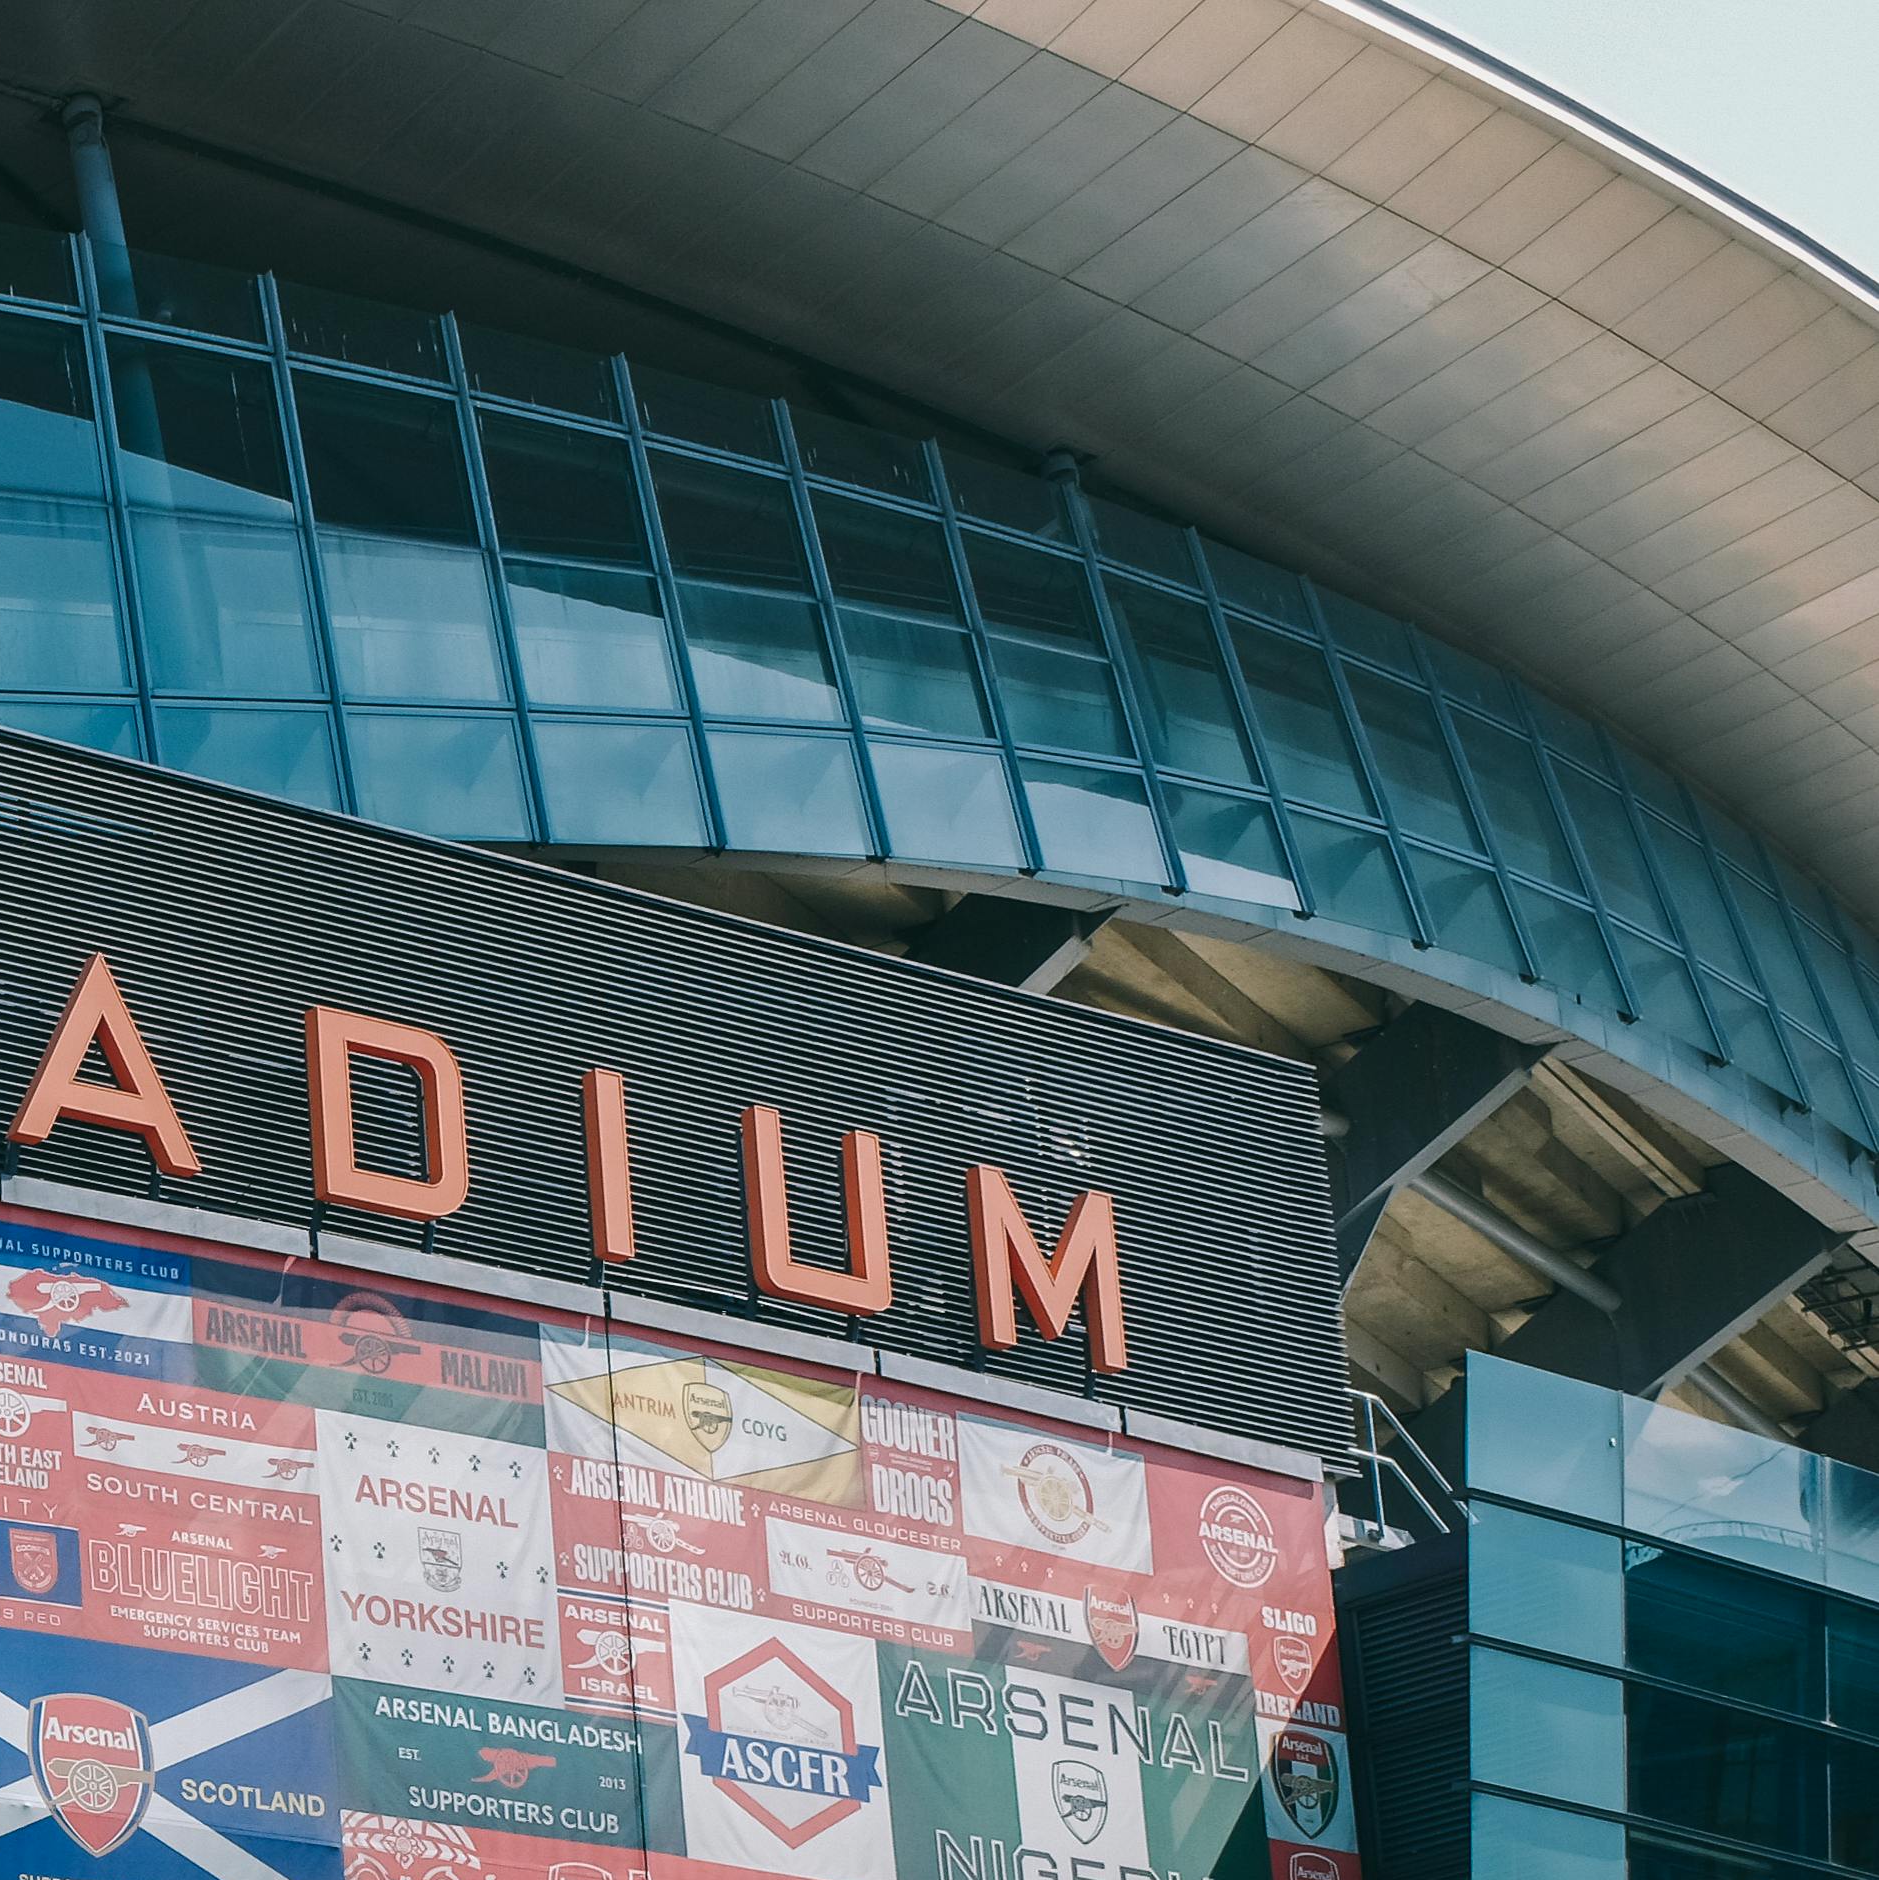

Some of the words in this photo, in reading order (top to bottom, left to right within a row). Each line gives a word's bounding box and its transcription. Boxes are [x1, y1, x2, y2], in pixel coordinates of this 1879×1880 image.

[741, 1416, 788, 1443] COYG
[862, 1394, 958, 1462] GOONER
[355, 1473, 520, 1528] ARSENAL
[873, 1463, 954, 1525] DROGS
[340, 1591, 546, 1650] YORKSHIRE
[374, 1695, 482, 1730] ARSENAL
[488, 1710, 644, 1754] BANGLADESH
[894, 1659, 1249, 1783] ARSENAL
[721, 1733, 850, 1797] ASCFR
[180, 1778, 326, 1817] SCOTLAND
